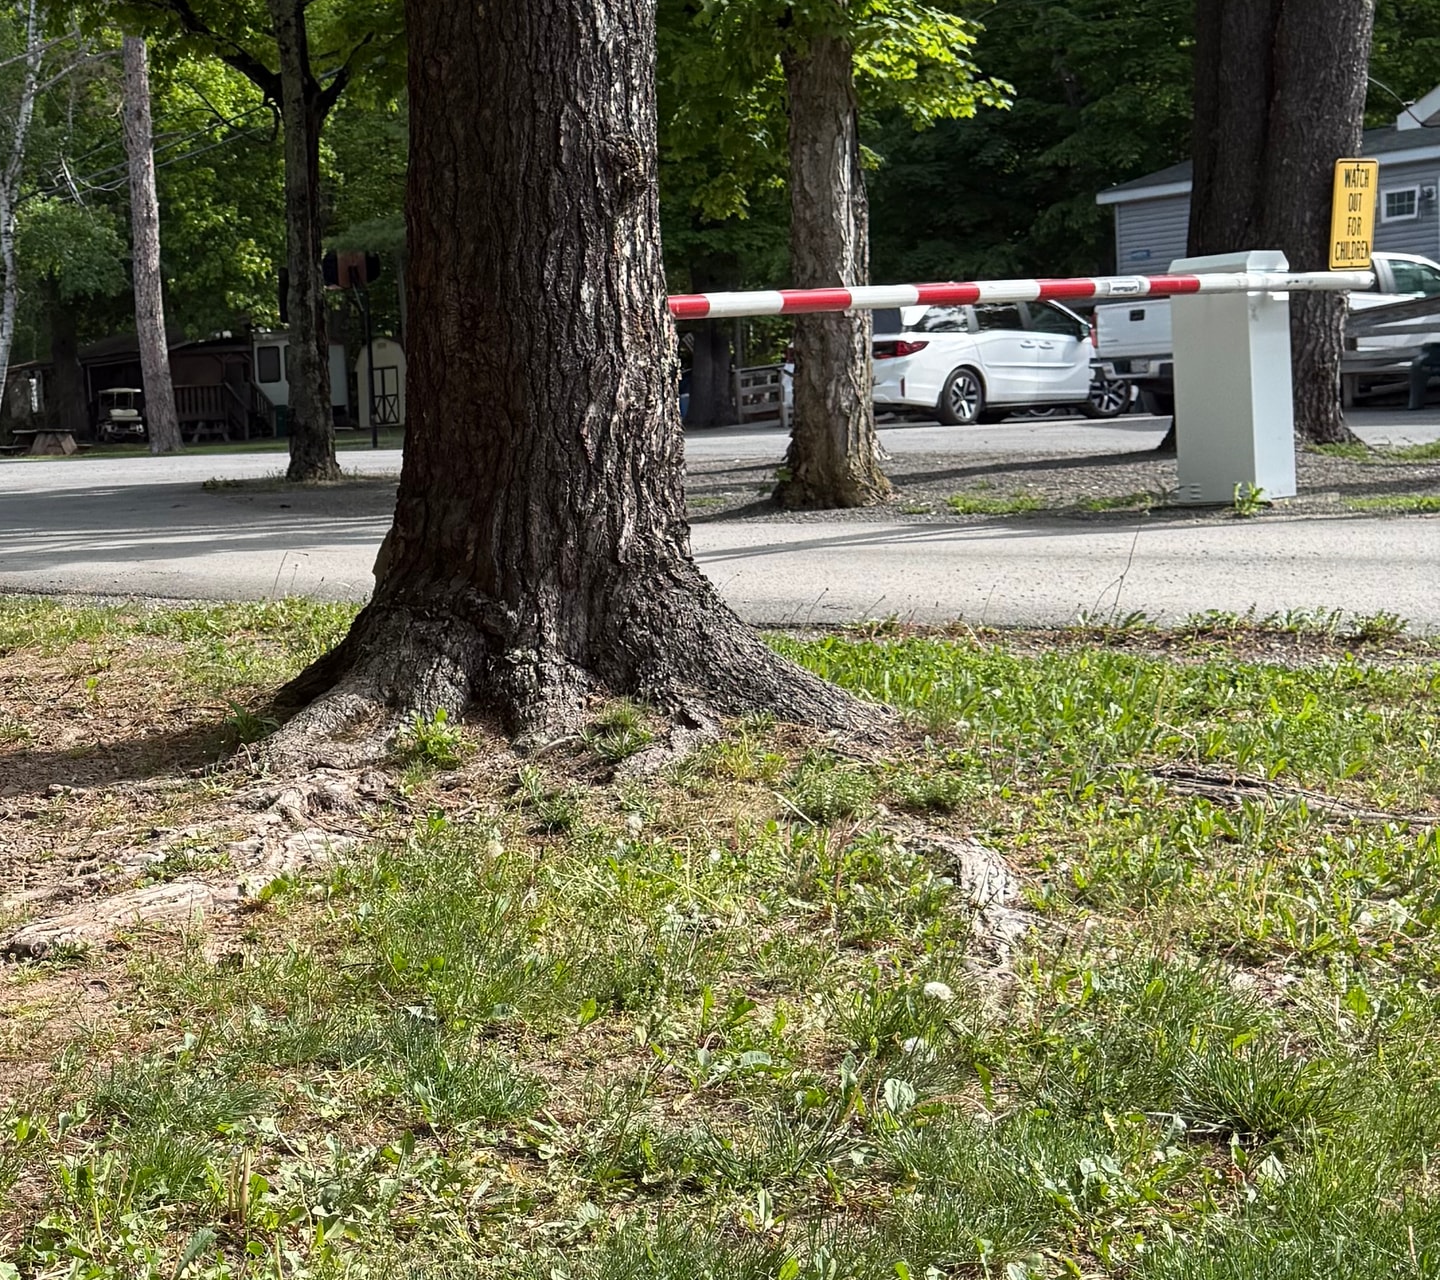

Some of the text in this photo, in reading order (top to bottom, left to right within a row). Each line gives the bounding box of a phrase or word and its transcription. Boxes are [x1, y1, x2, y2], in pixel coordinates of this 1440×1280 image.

[1344, 168, 1369, 188] WATCH
[1348, 193, 1362, 212] OUT
[1347, 217, 1362, 236] FOR
[1335, 240, 1369, 261] CHILDREN
